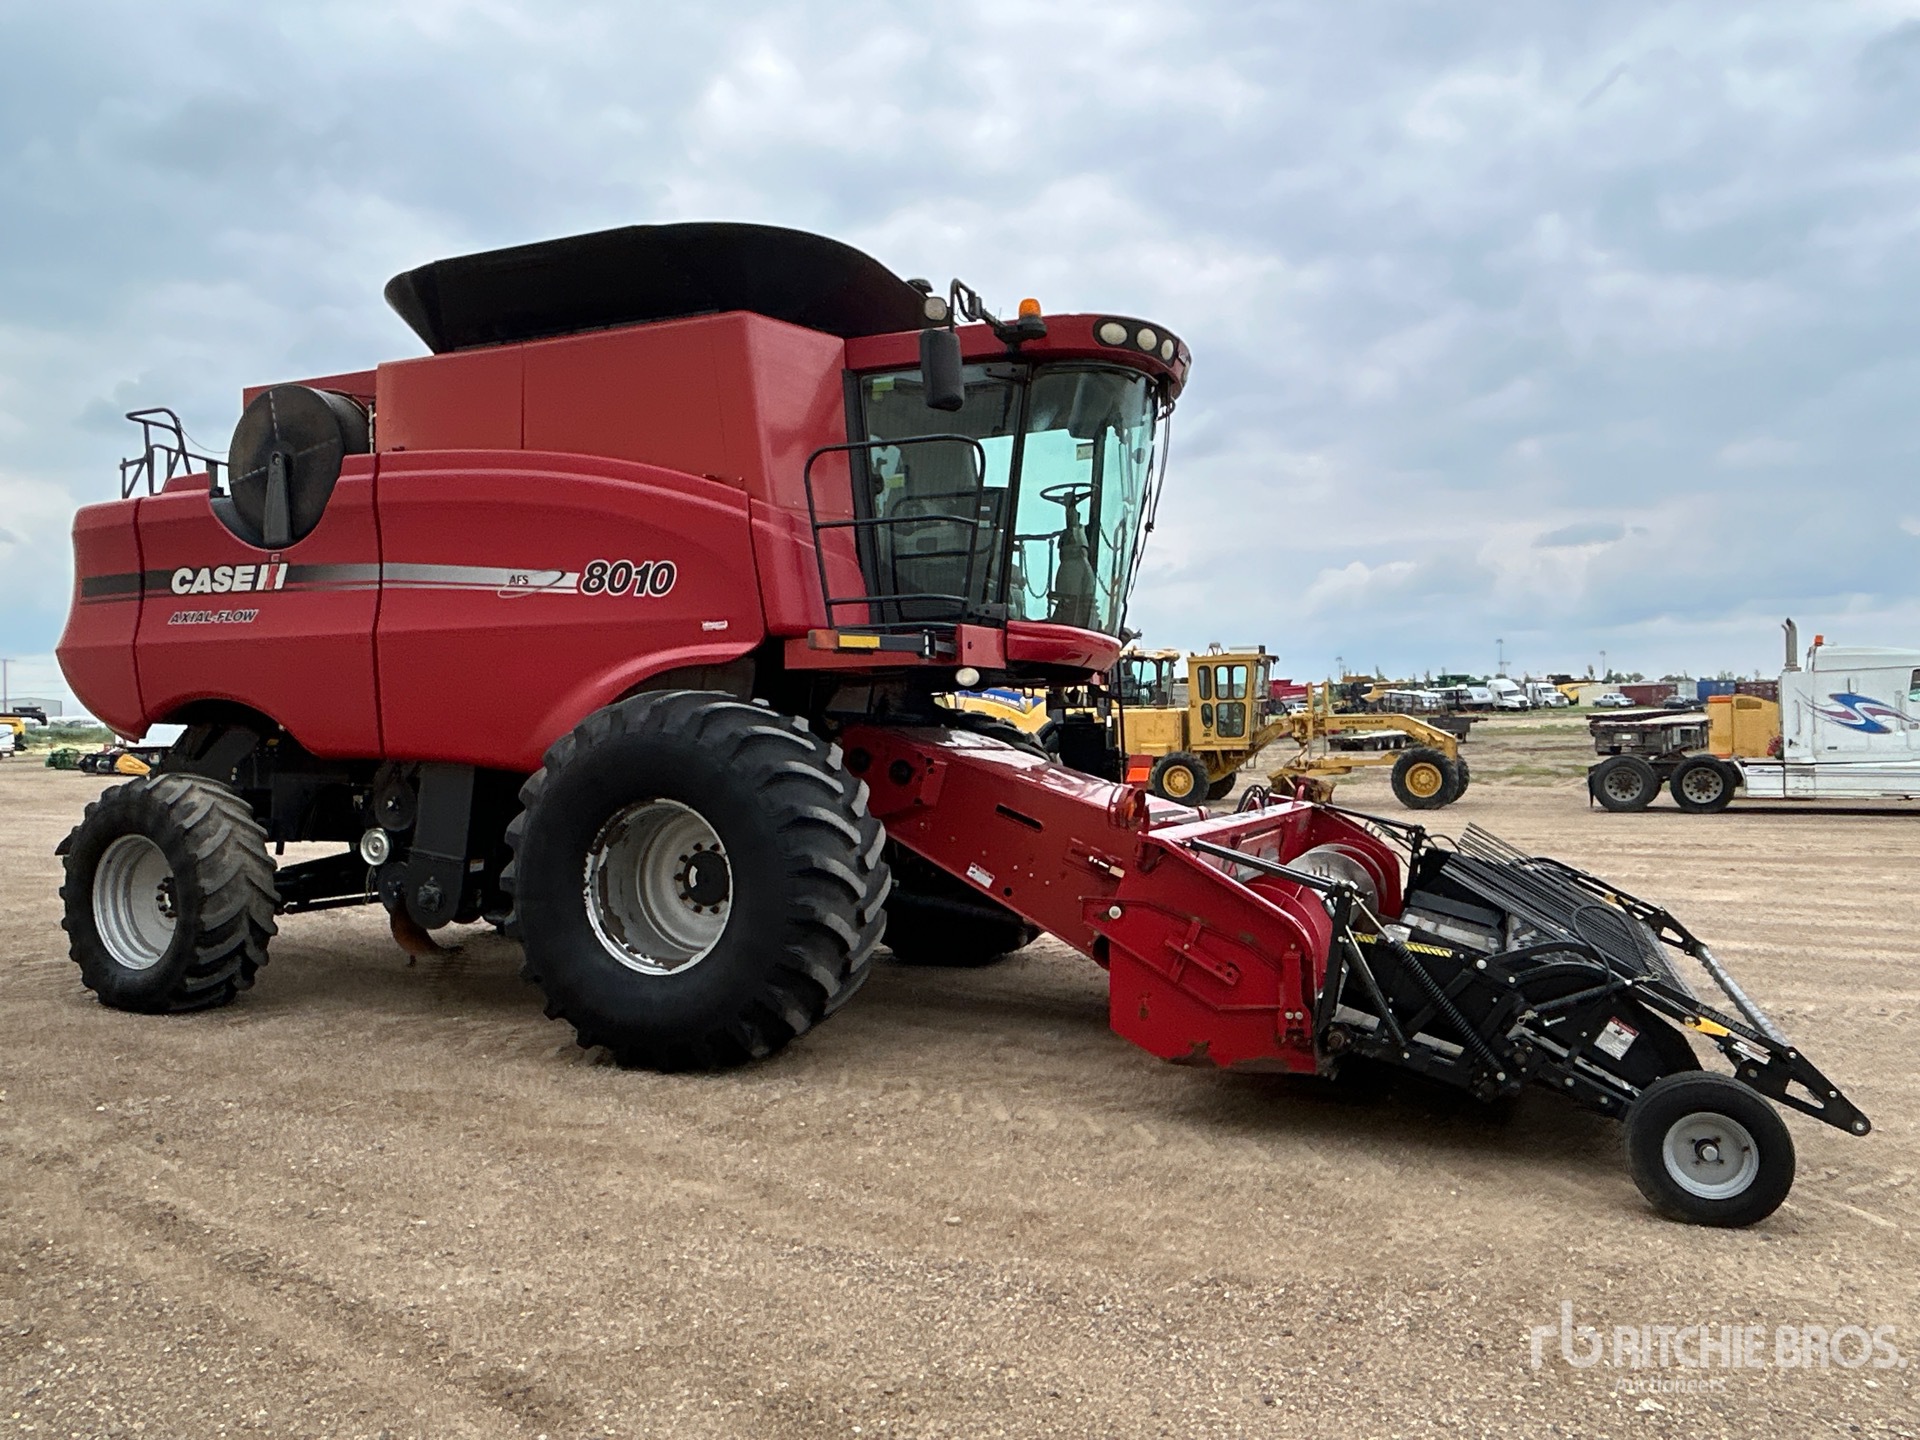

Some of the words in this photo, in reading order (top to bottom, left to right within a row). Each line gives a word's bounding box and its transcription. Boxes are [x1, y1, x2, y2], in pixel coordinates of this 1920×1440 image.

[171, 565, 256, 595] CASE
[508, 574, 529, 585] AFS
[580, 559, 677, 598] 8010
[168, 609, 259, 625] AXIAL-FLOW
